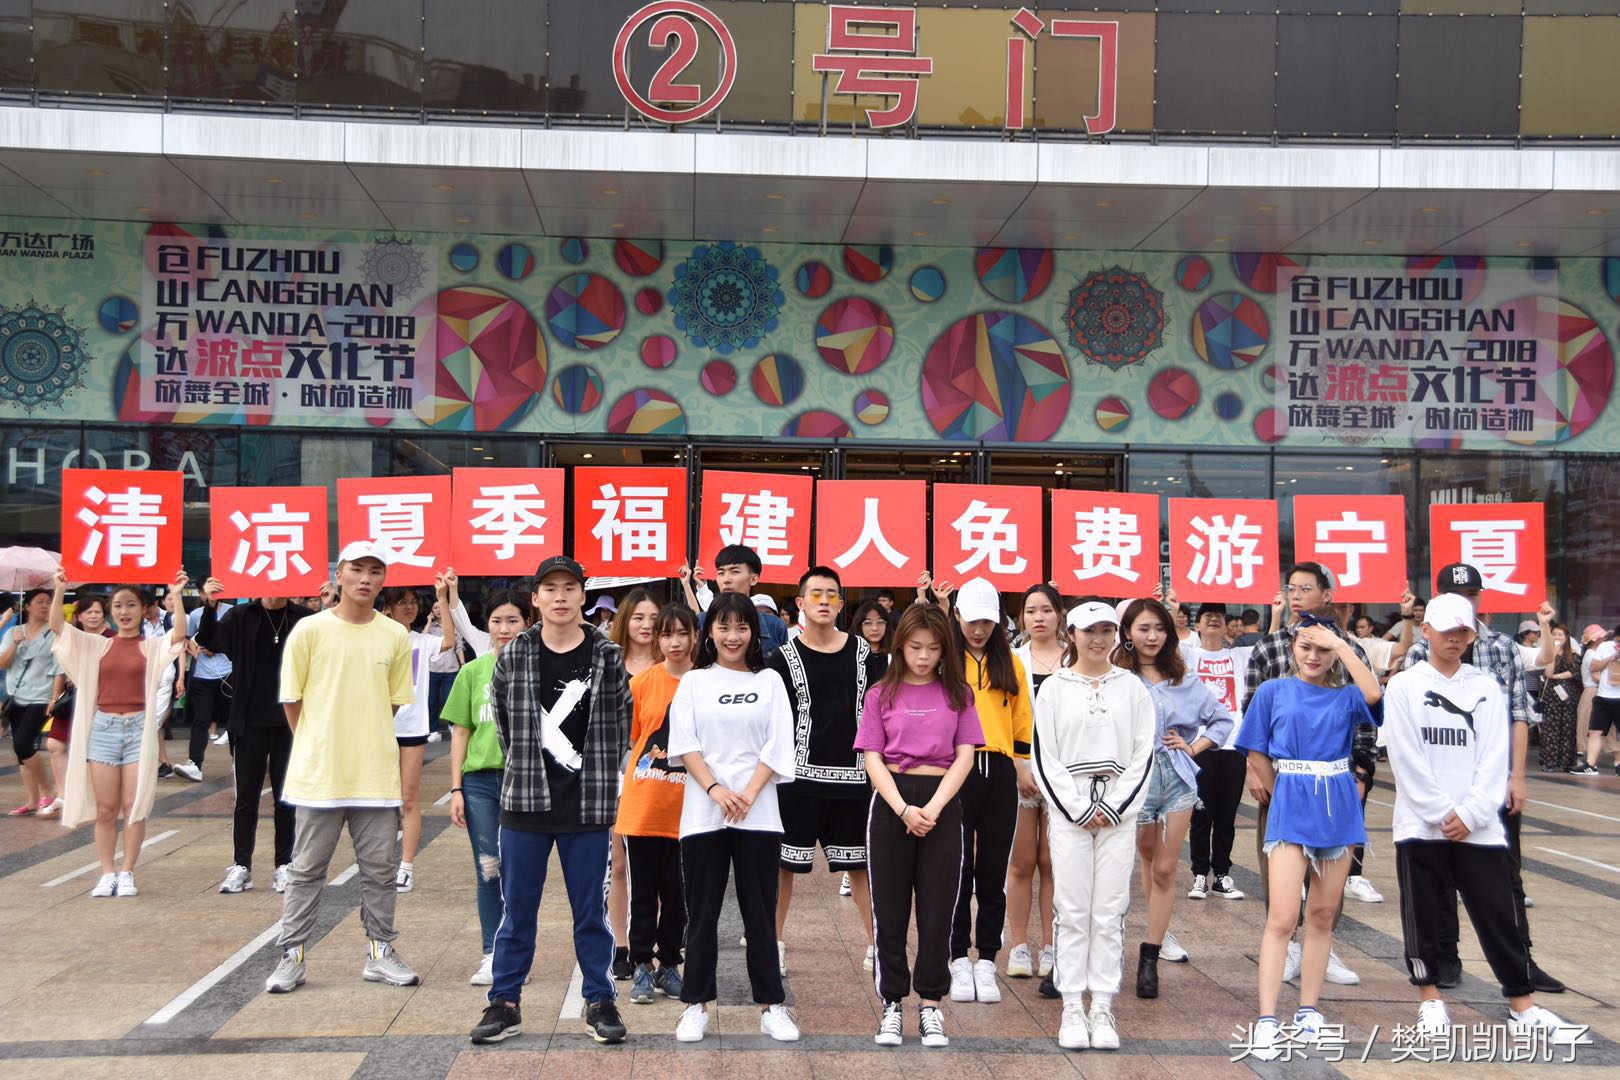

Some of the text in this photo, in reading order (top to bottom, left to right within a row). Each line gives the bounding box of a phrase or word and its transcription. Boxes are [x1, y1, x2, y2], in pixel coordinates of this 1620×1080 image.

[20, 250, 59, 258] WANDA
[62, 251, 94, 259] PLAZA
[197, 246, 340, 274] FUZHOU
[197, 278, 394, 308] CANGSHAN
[1327, 277, 1463, 301] FUZHOU
[1327, 308, 1515, 332] CANGSHAN
[195, 338, 416, 381] 波点文化节
[1324, 363, 1537, 404] 波点文化节
[718, 692, 759, 705] GEO
